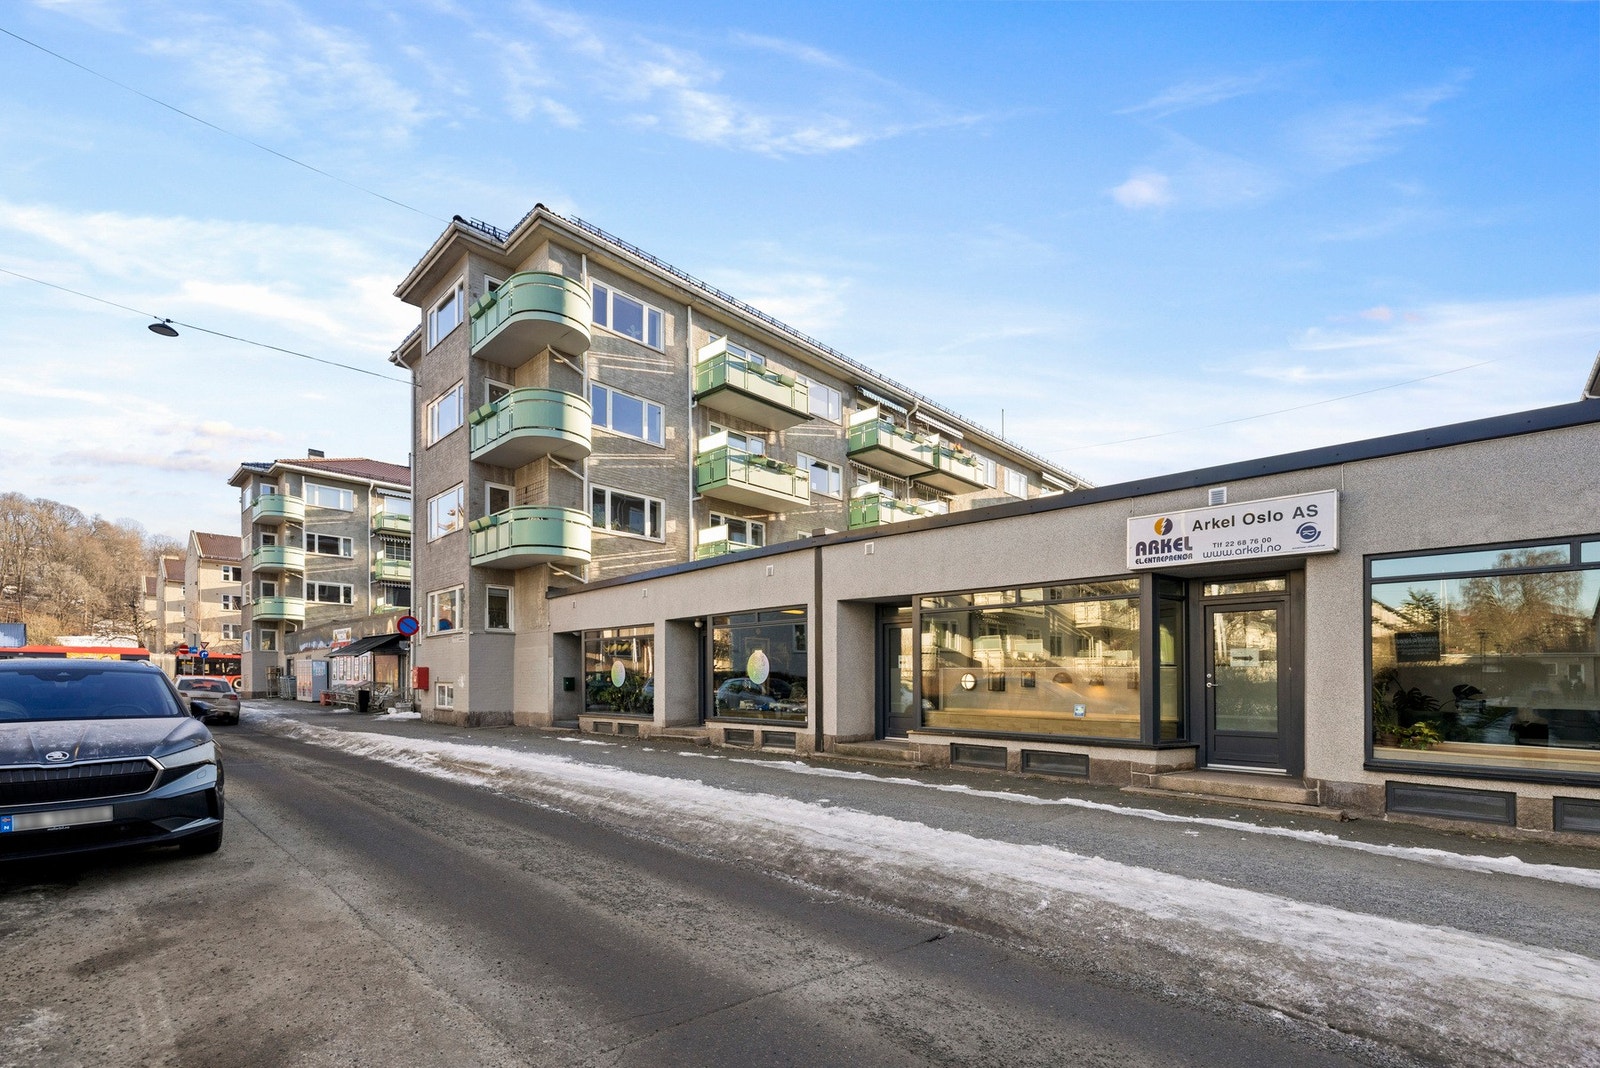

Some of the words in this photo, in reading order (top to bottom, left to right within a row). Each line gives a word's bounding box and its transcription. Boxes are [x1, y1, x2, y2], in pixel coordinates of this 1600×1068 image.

[1192, 515, 1235, 532] Arkel
[1243, 510, 1283, 525] Oslo
[1292, 504, 1318, 520] AS
[1136, 536, 1193, 556] ARKEL
[1202, 544, 1282, 558] www.arkel.no
